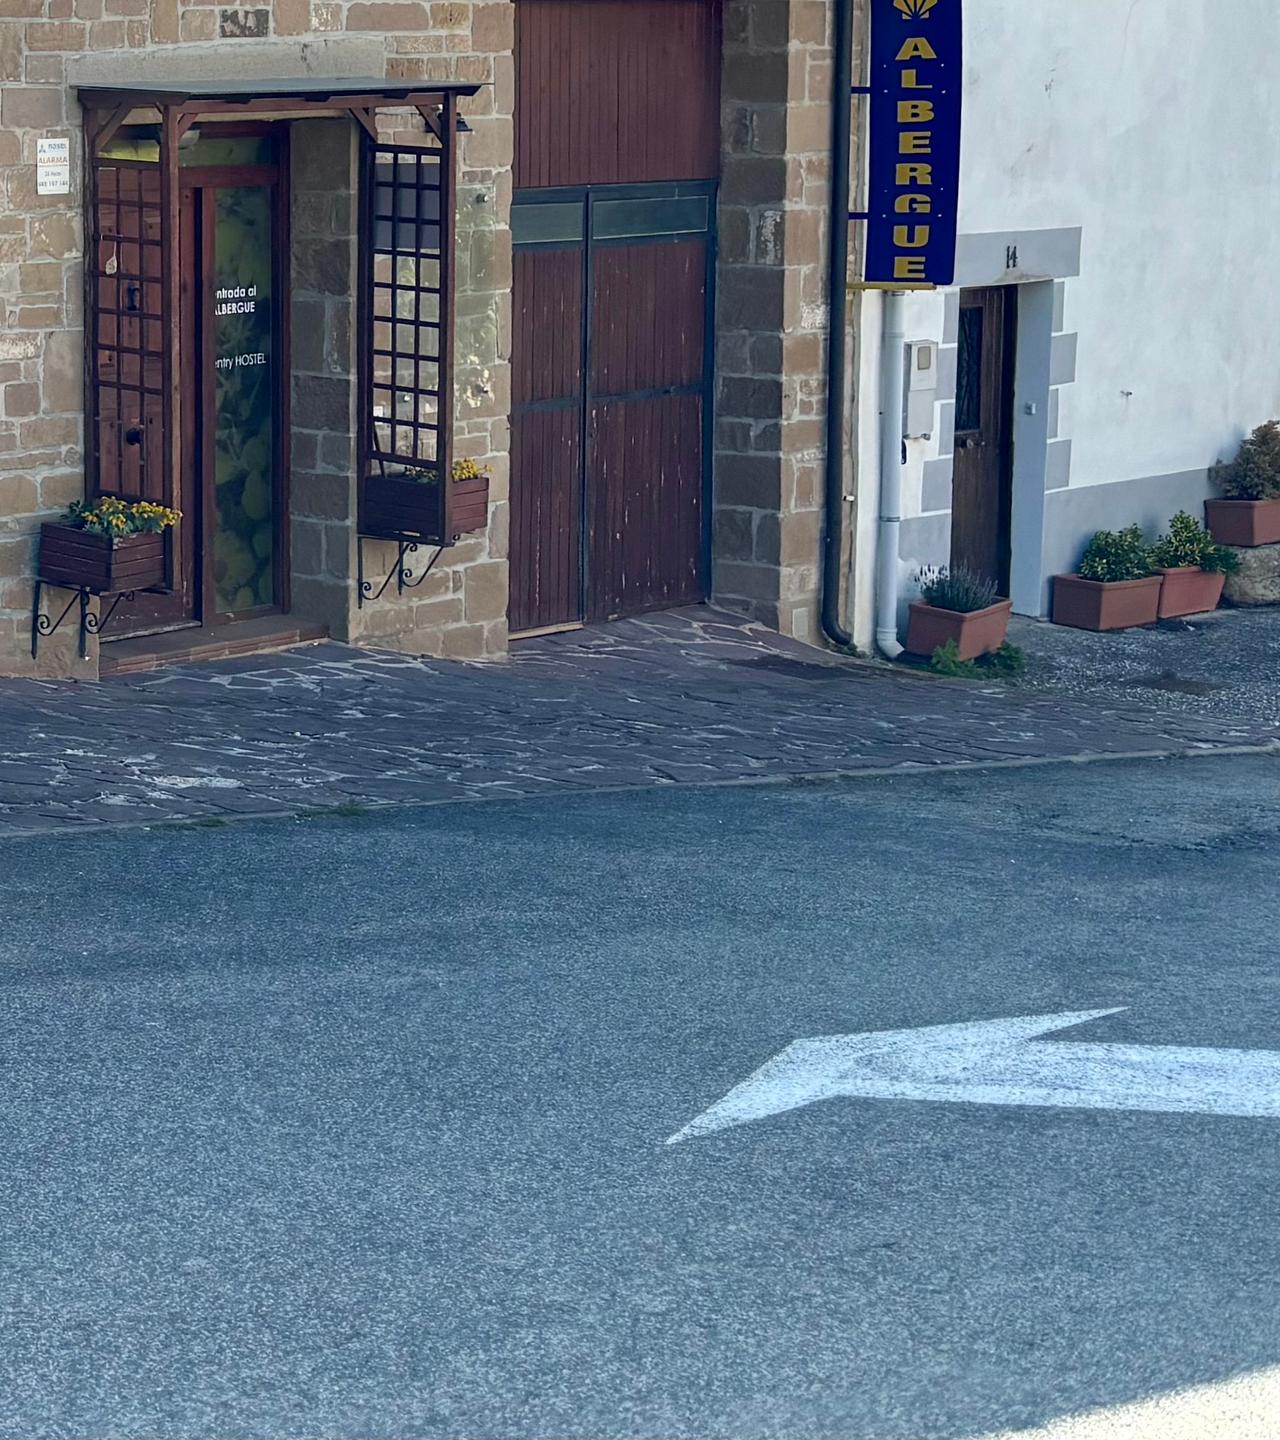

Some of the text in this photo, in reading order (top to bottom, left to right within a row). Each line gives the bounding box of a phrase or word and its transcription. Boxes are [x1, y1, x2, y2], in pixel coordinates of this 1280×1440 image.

[893, 37, 938, 279] ALBERGUE
[1006, 245, 1018, 268] 14
[216, 284, 257, 299] ntrada al
[235, 353, 266, 367] HOSTEL
